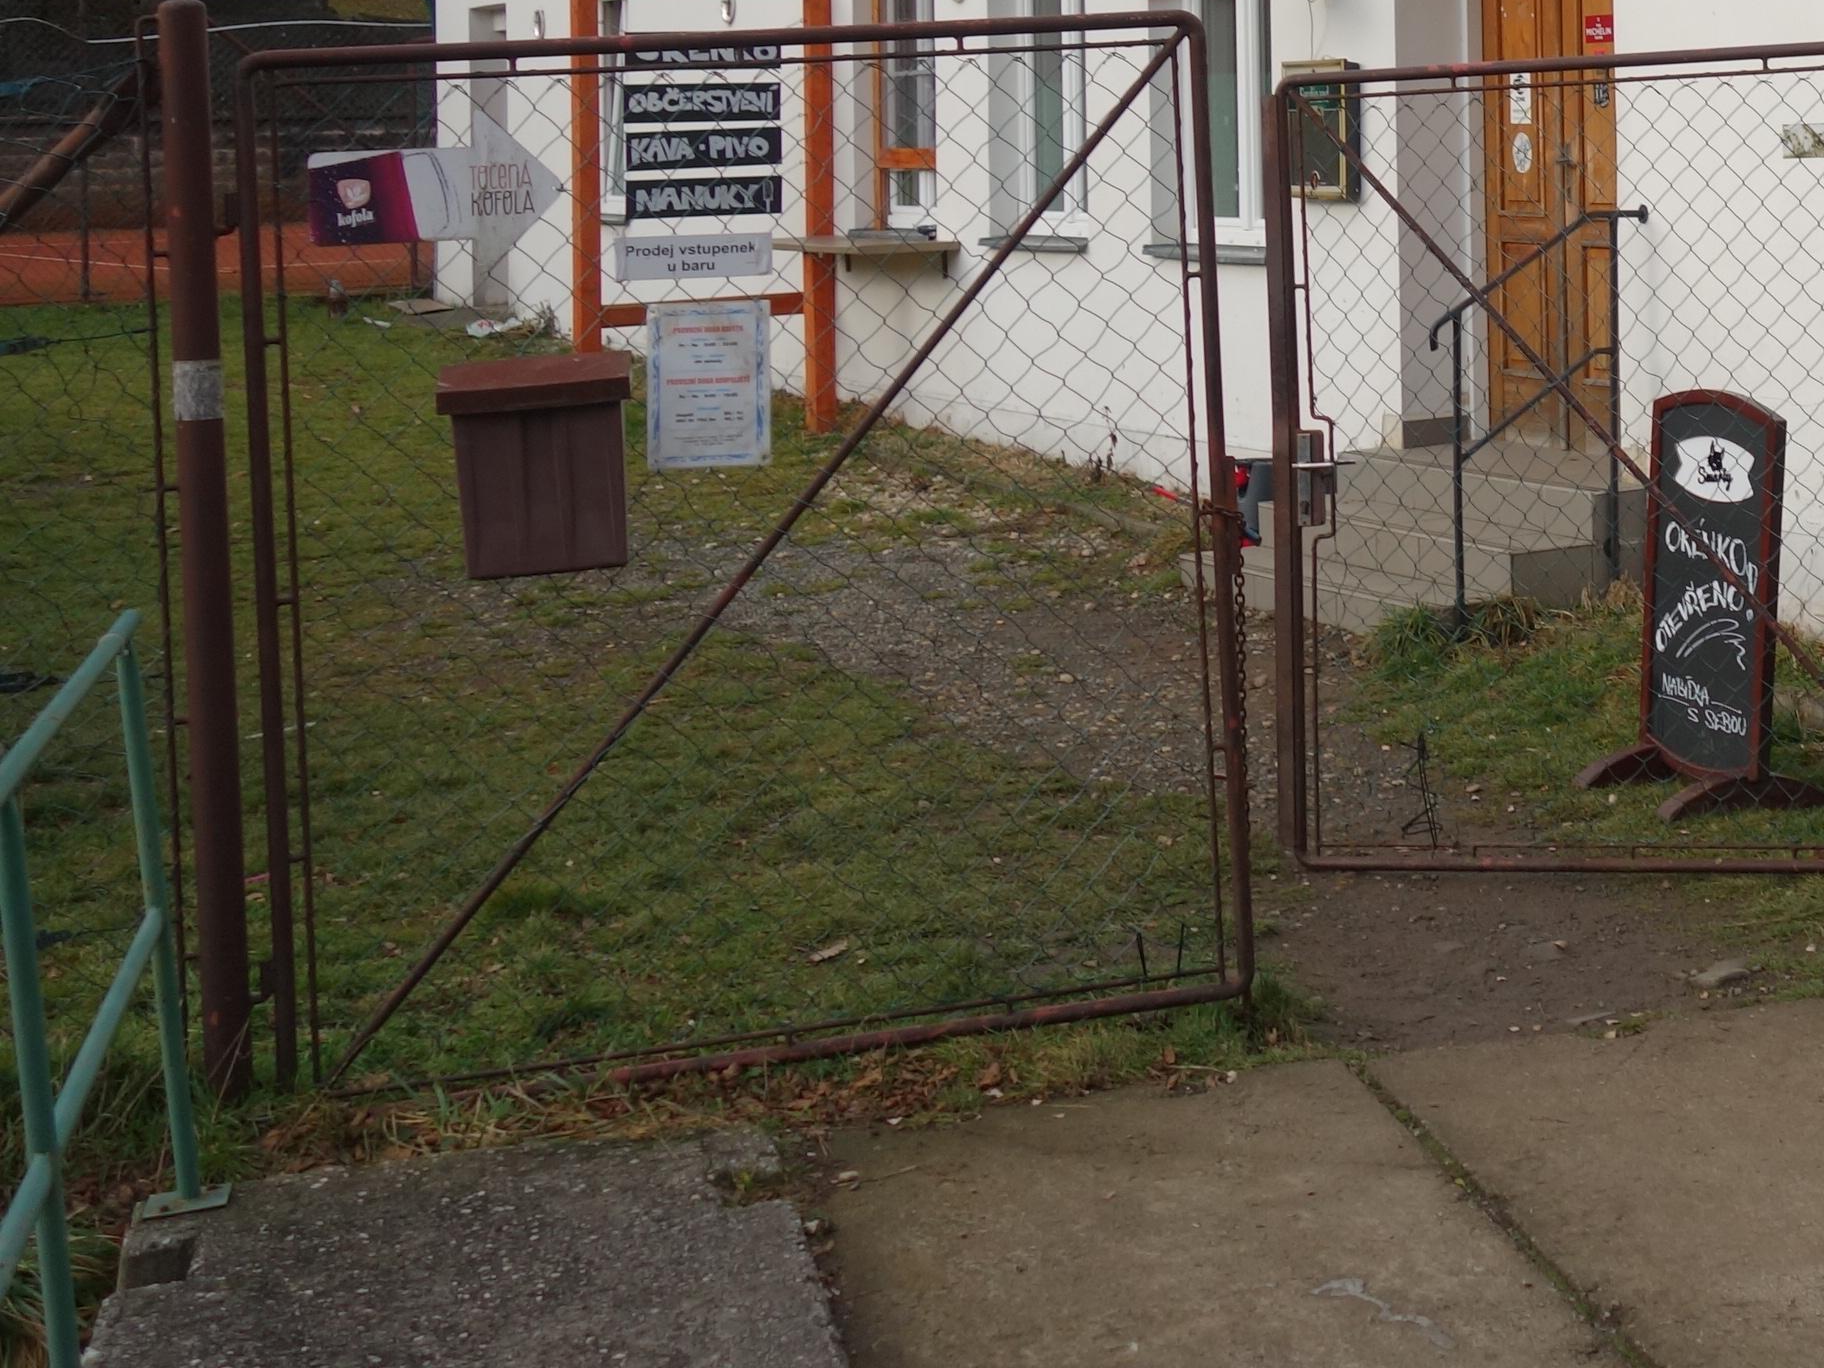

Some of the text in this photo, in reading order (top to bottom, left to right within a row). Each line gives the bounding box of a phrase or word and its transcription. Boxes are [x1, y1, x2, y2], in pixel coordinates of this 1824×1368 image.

[628, 84, 779, 113] OBČERSTVENÍ
[630, 134, 696, 167] KÁVA
[708, 135, 770, 160] PIVO
[470, 190, 536, 217] KOFOLA
[635, 183, 763, 212] NANUKY
[336, 208, 375, 229] kofola
[625, 241, 757, 258] Prodej vstupenek
[667, 260, 716, 272] u baru
[1704, 709, 1747, 736] SEBOU
